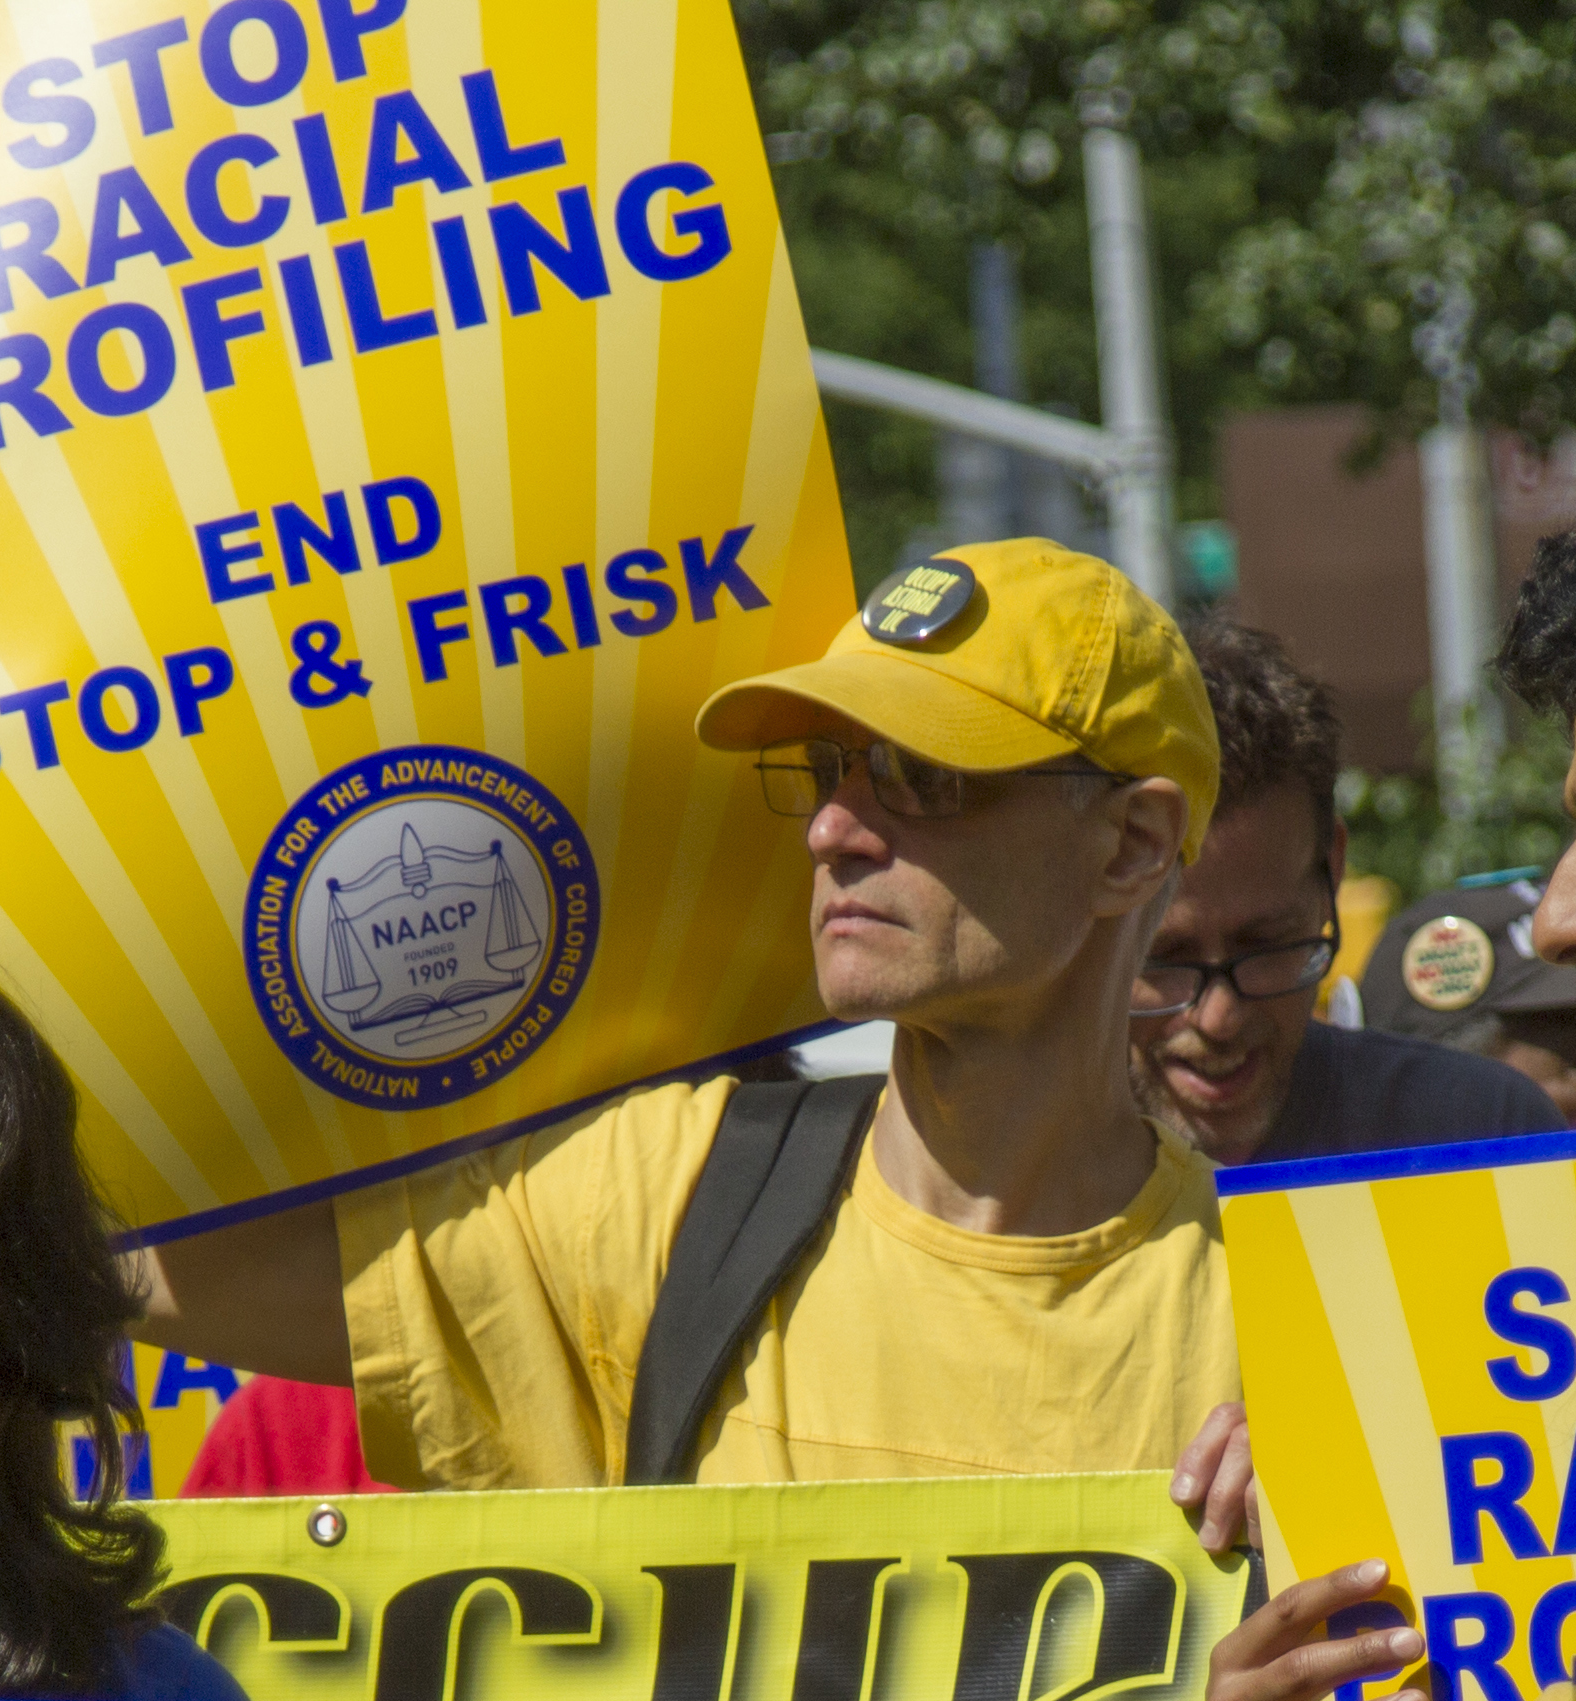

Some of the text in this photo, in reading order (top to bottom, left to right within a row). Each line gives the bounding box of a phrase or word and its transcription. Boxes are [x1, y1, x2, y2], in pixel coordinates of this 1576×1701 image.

[2, 0, 411, 170] STOP
[194, 475, 443, 605] END
[289, 619, 375, 710] &
[407, 523, 772, 684] FRISK
[257, 759, 587, 1097] NATIONAL ASSOCIATION FOR THE ADVANCEMENT OF COLORED PEOPLE
[371, 900, 477, 949] NAACP
[403, 942, 455, 962] FOUNDED
[407, 958, 458, 986] 1909
